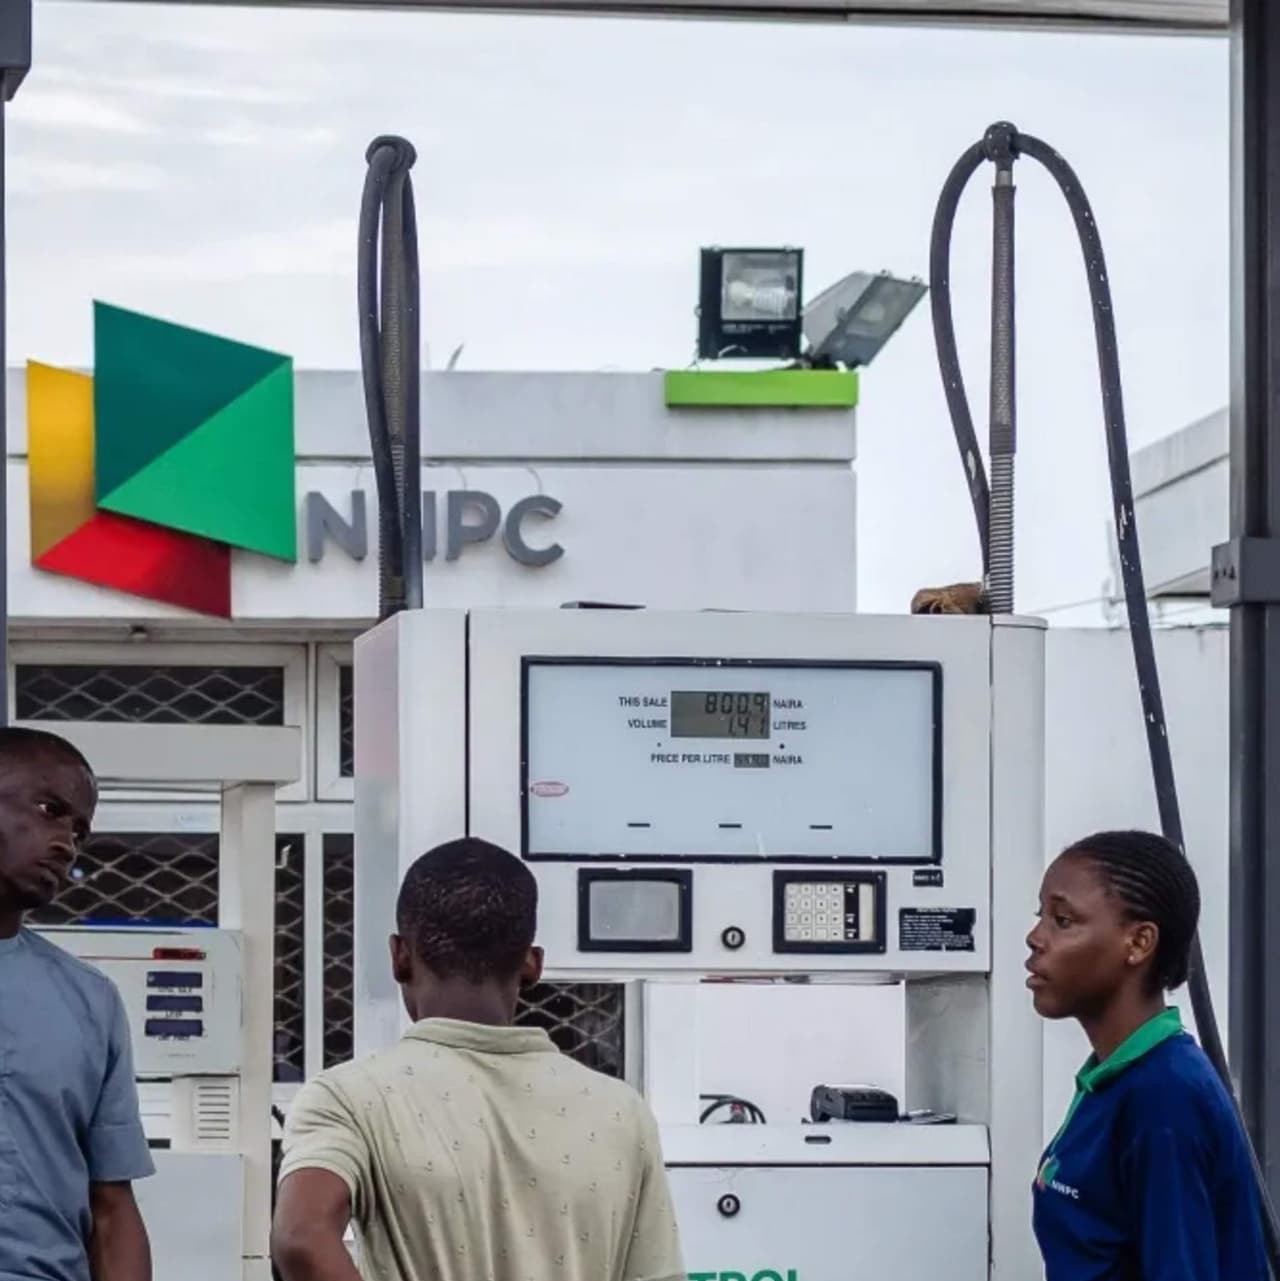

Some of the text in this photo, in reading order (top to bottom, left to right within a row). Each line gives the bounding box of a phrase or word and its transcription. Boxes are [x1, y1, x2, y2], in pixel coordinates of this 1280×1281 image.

[306, 489, 565, 568] NPC
[618, 696, 642, 708] THIS
[643, 697, 668, 708] SALE
[773, 699, 803, 710] NAIRA
[628, 719, 668, 729] VOLUME
[773, 721, 807, 731] LITRES
[651, 753, 679, 764] PRICE
[681, 753, 701, 764] PER
[703, 754, 731, 765] LITRE
[773, 755, 803, 765] NAIRA
